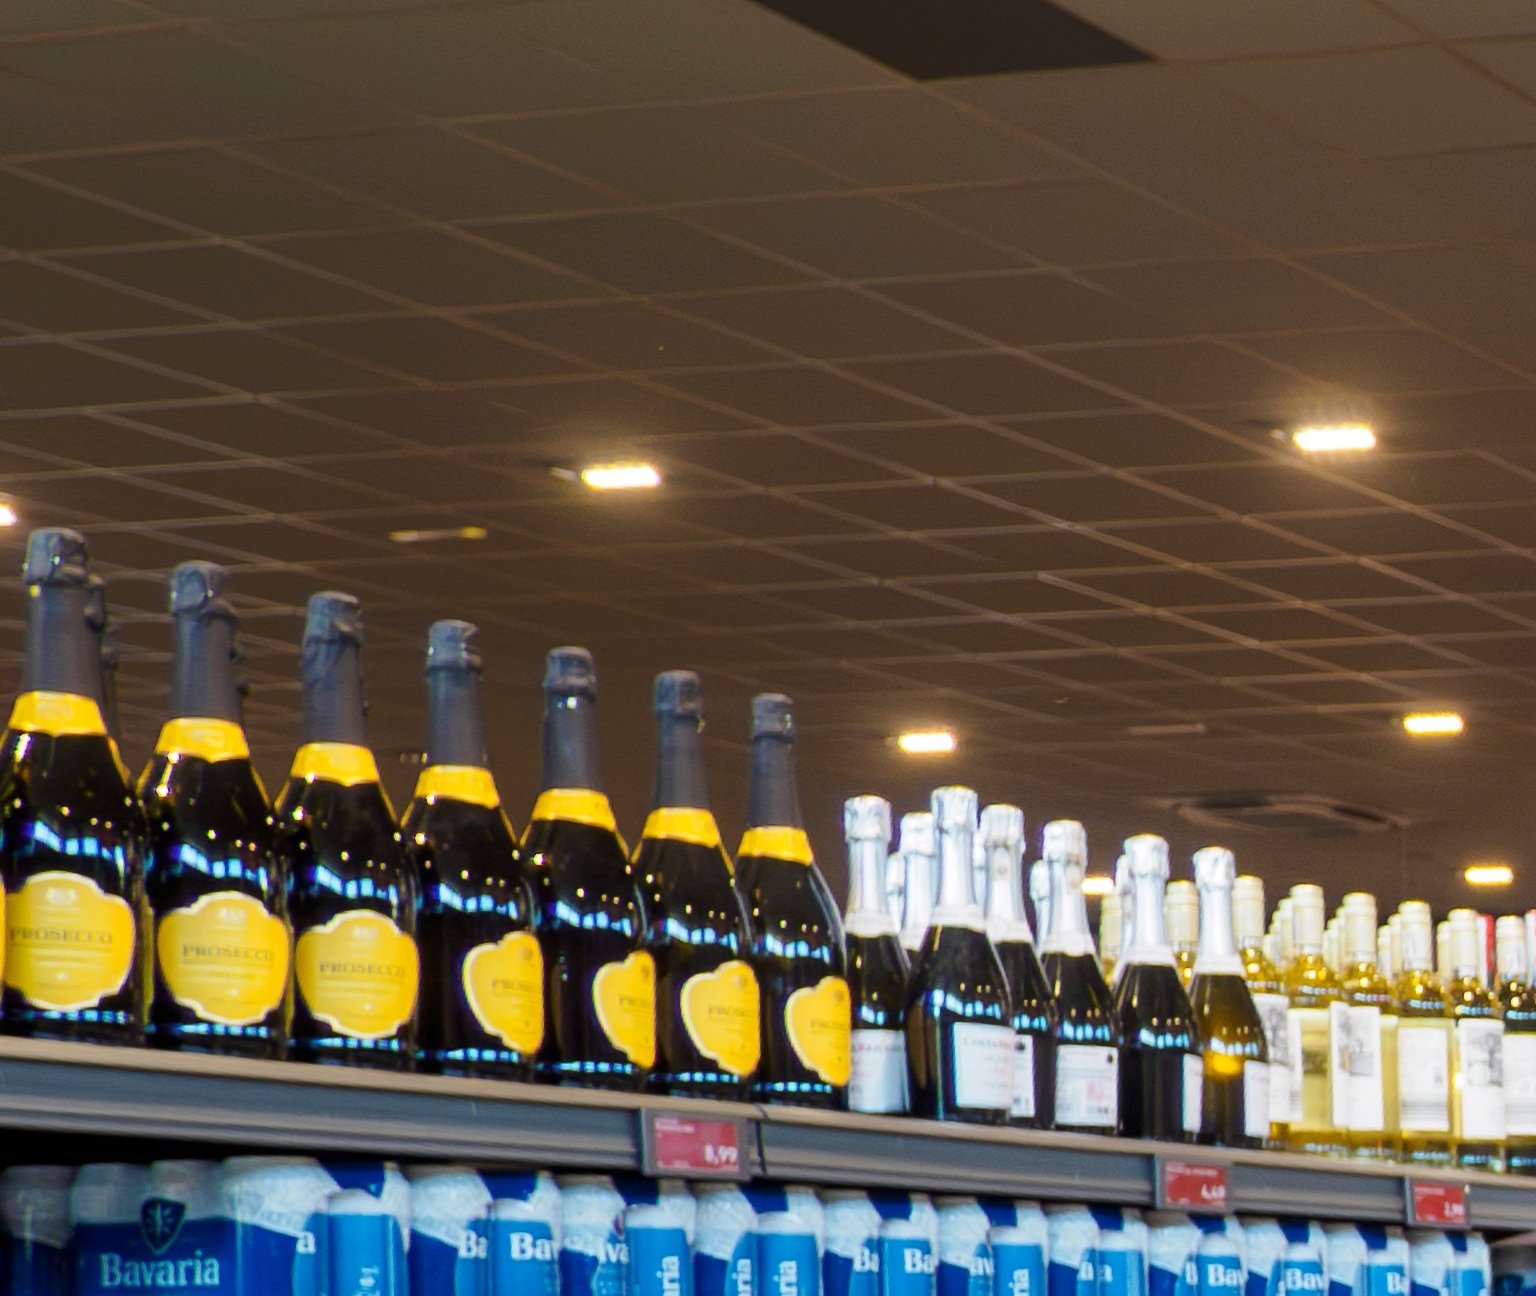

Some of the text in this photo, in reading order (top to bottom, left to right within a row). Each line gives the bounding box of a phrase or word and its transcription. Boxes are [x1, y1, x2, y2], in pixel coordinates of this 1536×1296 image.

[9, 926, 114, 945] PROSECCO
[180, 943, 276, 961] PROSECCO
[317, 958, 407, 978] PROSECCO
[99, 1249, 220, 1287] Bavaria
